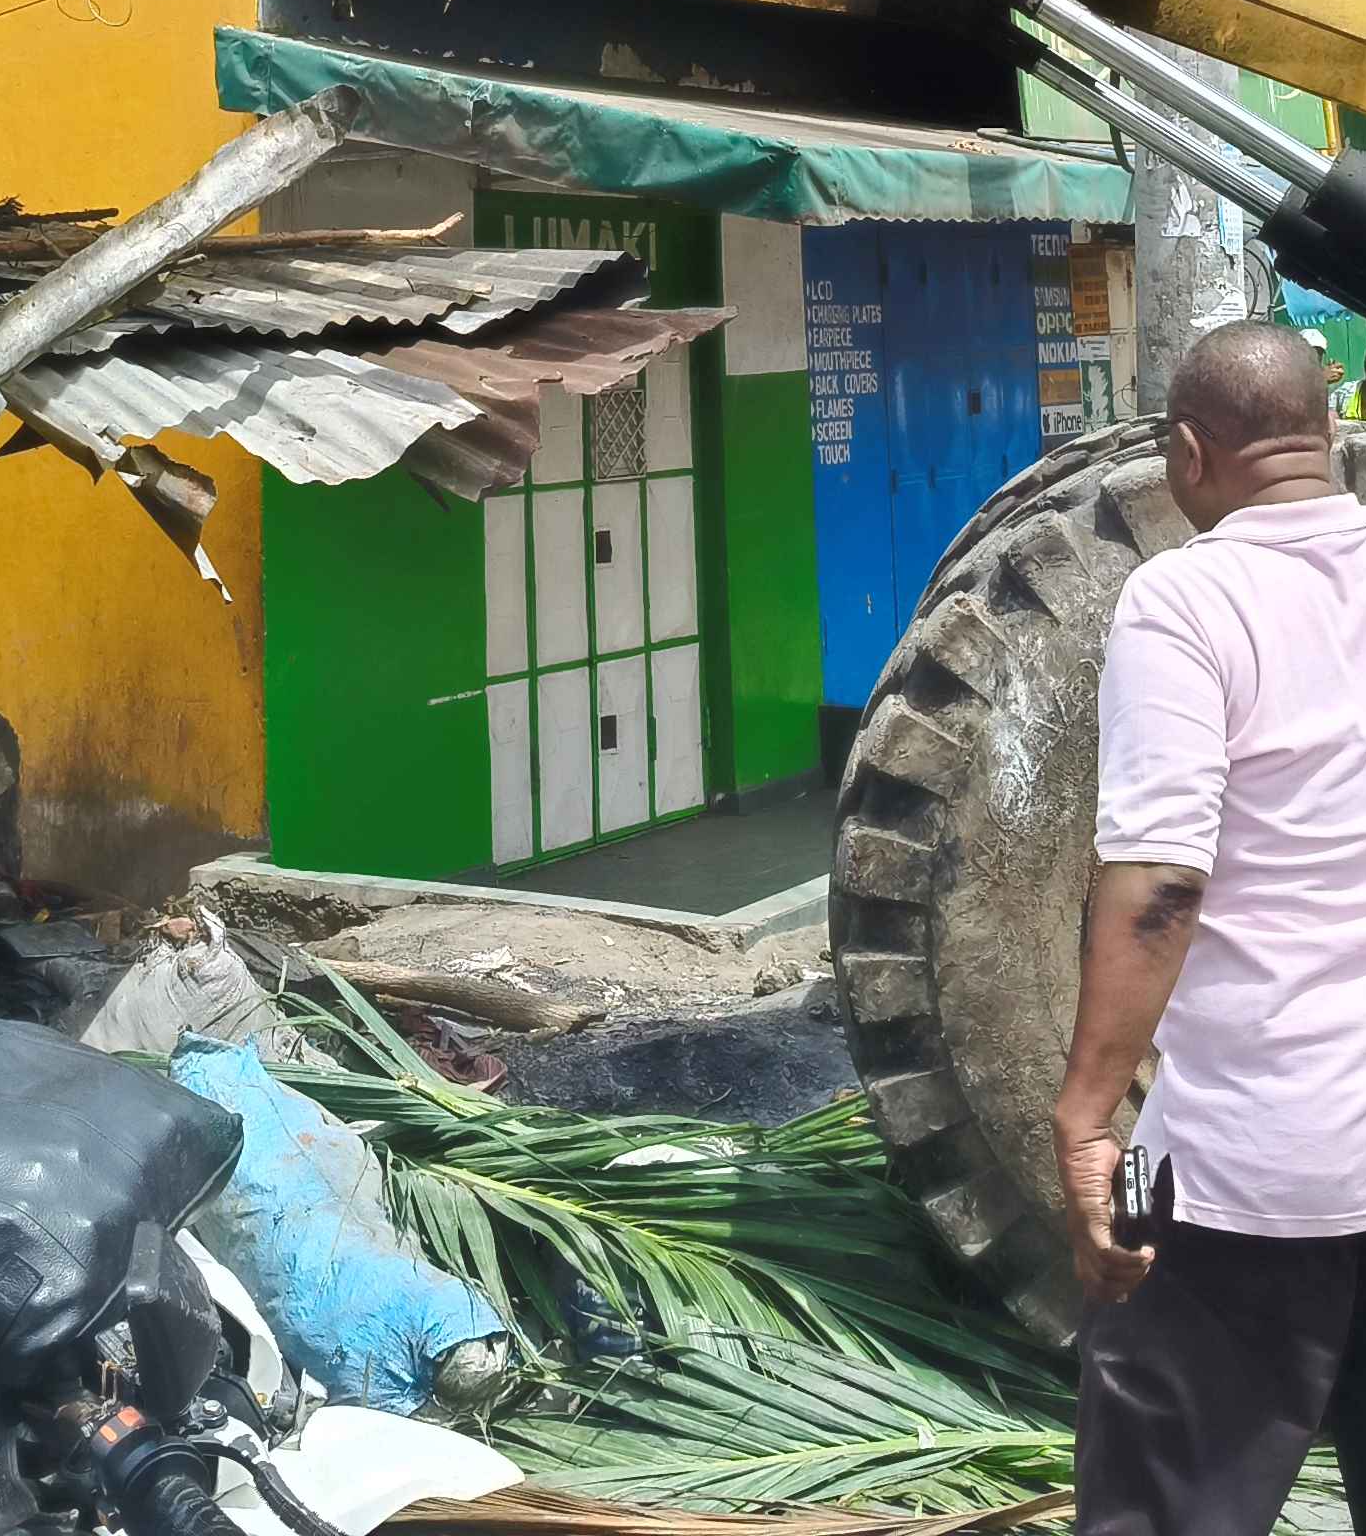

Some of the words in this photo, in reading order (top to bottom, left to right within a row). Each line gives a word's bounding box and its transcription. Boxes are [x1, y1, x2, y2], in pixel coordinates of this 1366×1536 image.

[811, 280, 833, 300] LCD
[852, 305, 882, 324] PLATES
[813, 327, 853, 347] EARPIECE
[814, 350, 872, 371] MOUTHPIECE
[1038, 342, 1079, 364] NOKIA
[815, 375, 839, 395] BACK
[844, 373, 878, 394] COVERS
[816, 398, 854, 418] FLAMES
[816, 421, 853, 442] SCREEN
[1053, 411, 1082, 433] iPhone
[818, 444, 850, 465] TOUCH
